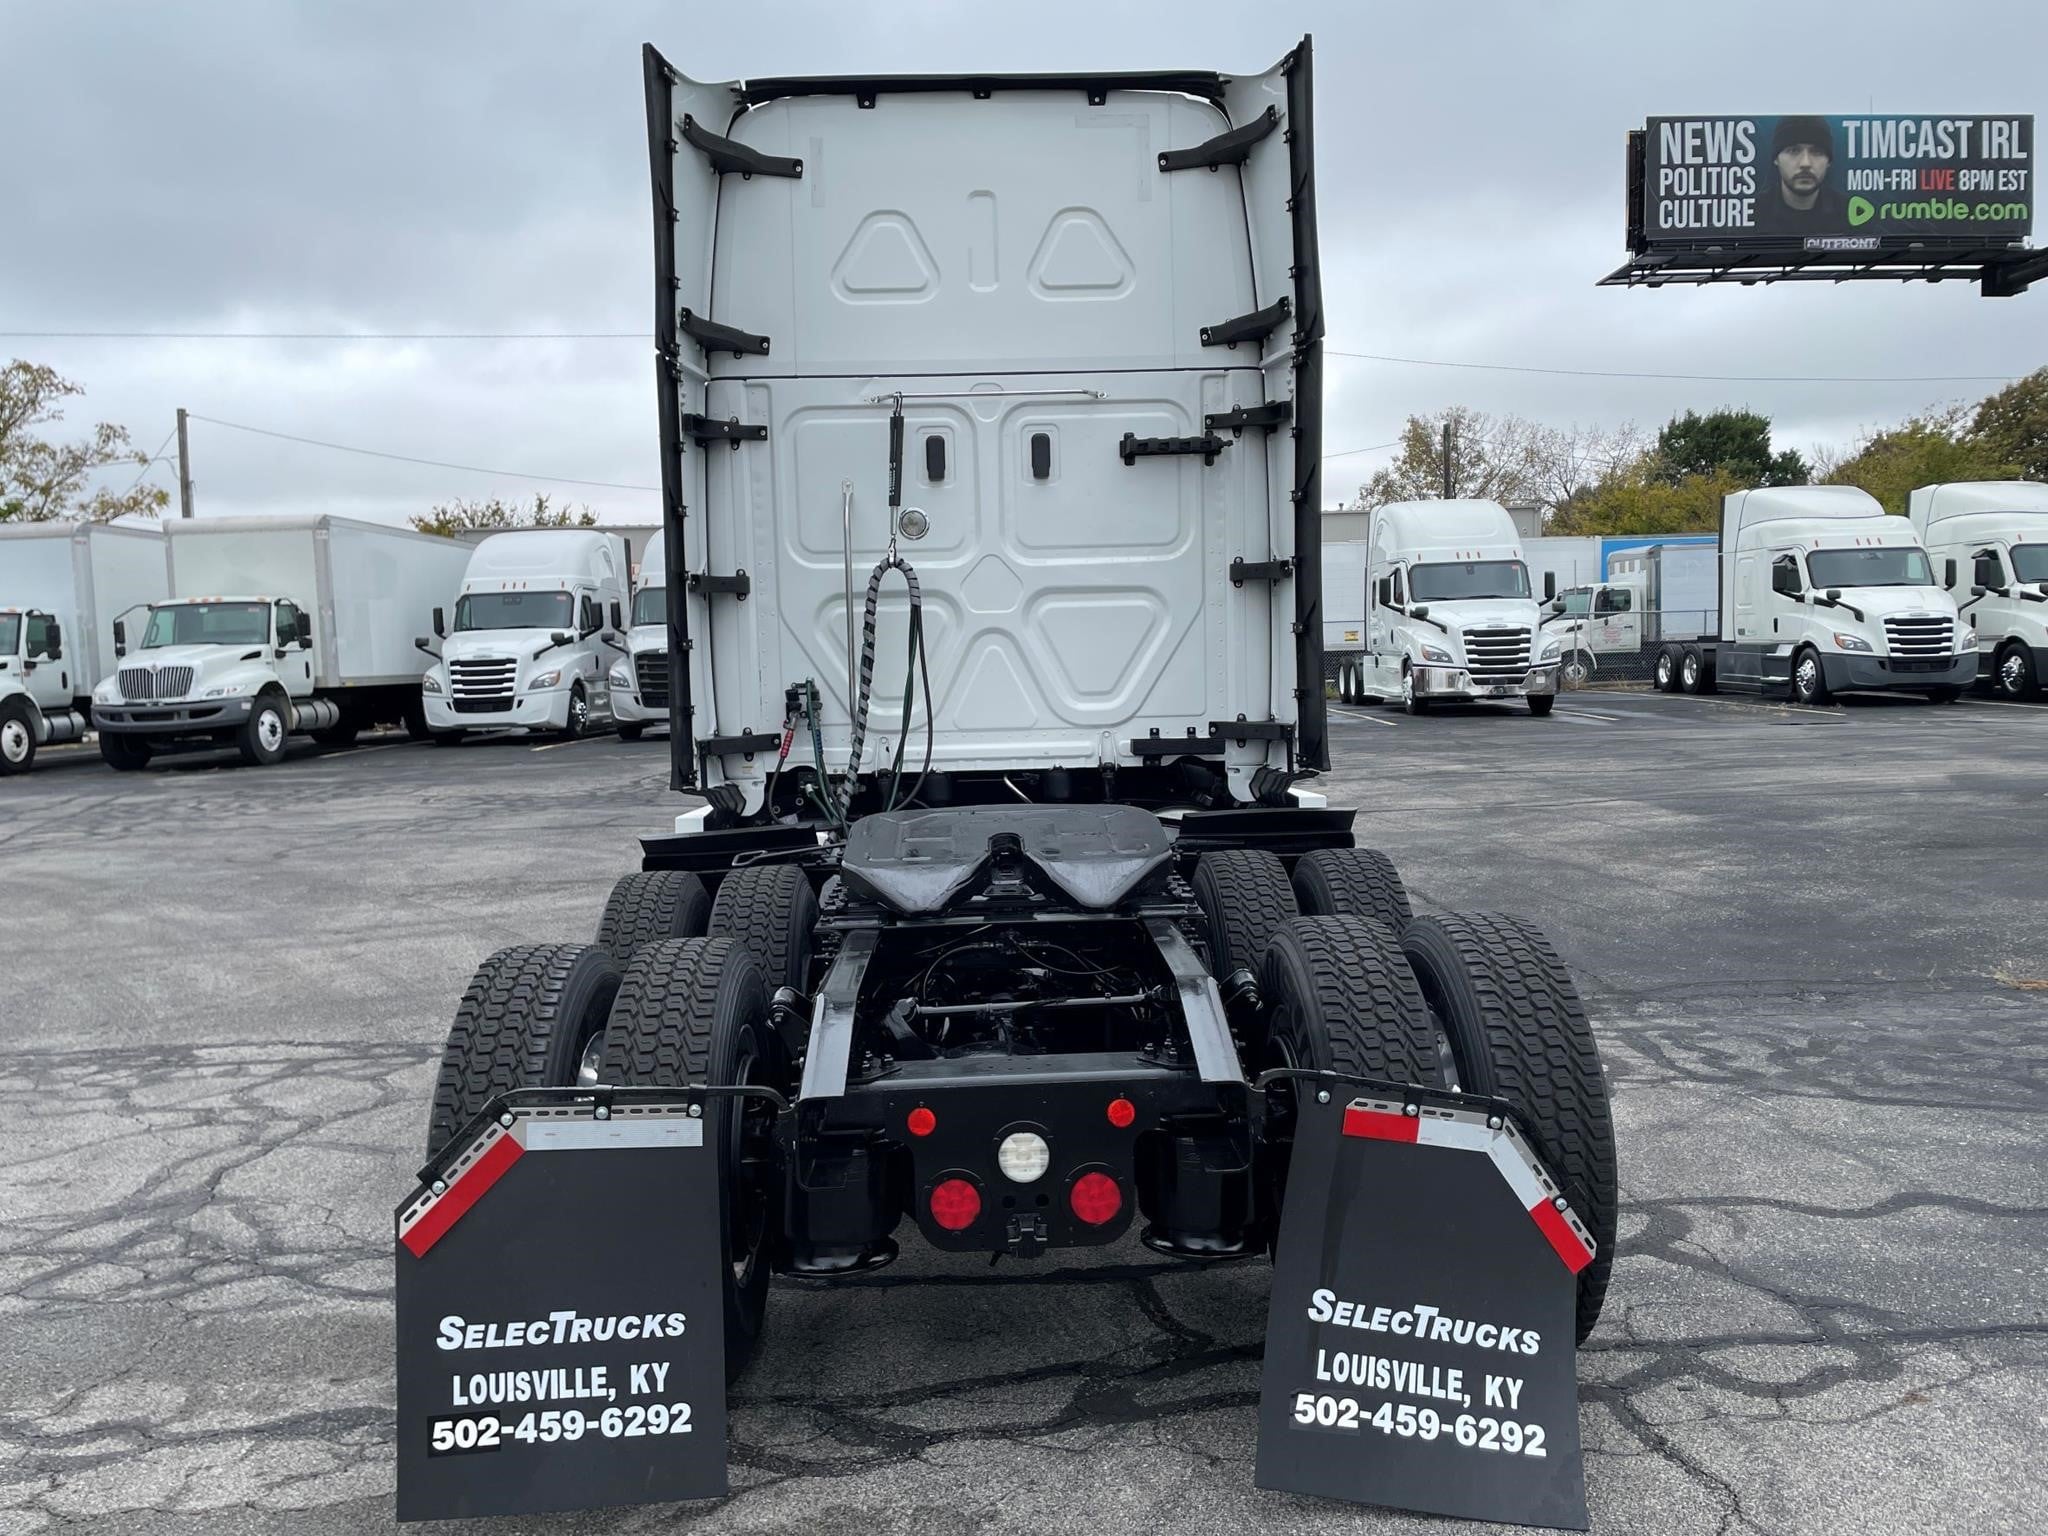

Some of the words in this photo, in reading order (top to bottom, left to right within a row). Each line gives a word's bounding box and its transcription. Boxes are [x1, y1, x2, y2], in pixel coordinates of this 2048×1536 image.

[1659, 120, 1756, 165] NEWS
[1842, 120, 1973, 159] TIMCAST
[1981, 120, 2028, 160] IRL
[1659, 166, 1756, 197] POLITICS
[1847, 168, 1916, 191] MON-FRI
[1920, 168, 1955, 191] LIVE
[1959, 169, 1993, 191] 8PM
[1998, 169, 2028, 191] EST
[1659, 198, 1756, 229] CULTURE
[1879, 196, 2028, 221] rumble.com
[452, 1365, 616, 1406] LOUISVILLE,
[630, 1362, 670, 1395] KY
[1316, 1349, 1471, 1408] LOUISVILLE,
[1484, 1374, 1524, 1410] KY
[431, 1402, 693, 1451] 502-459-6292
[1294, 1394, 1547, 1457] 502-459-6292
